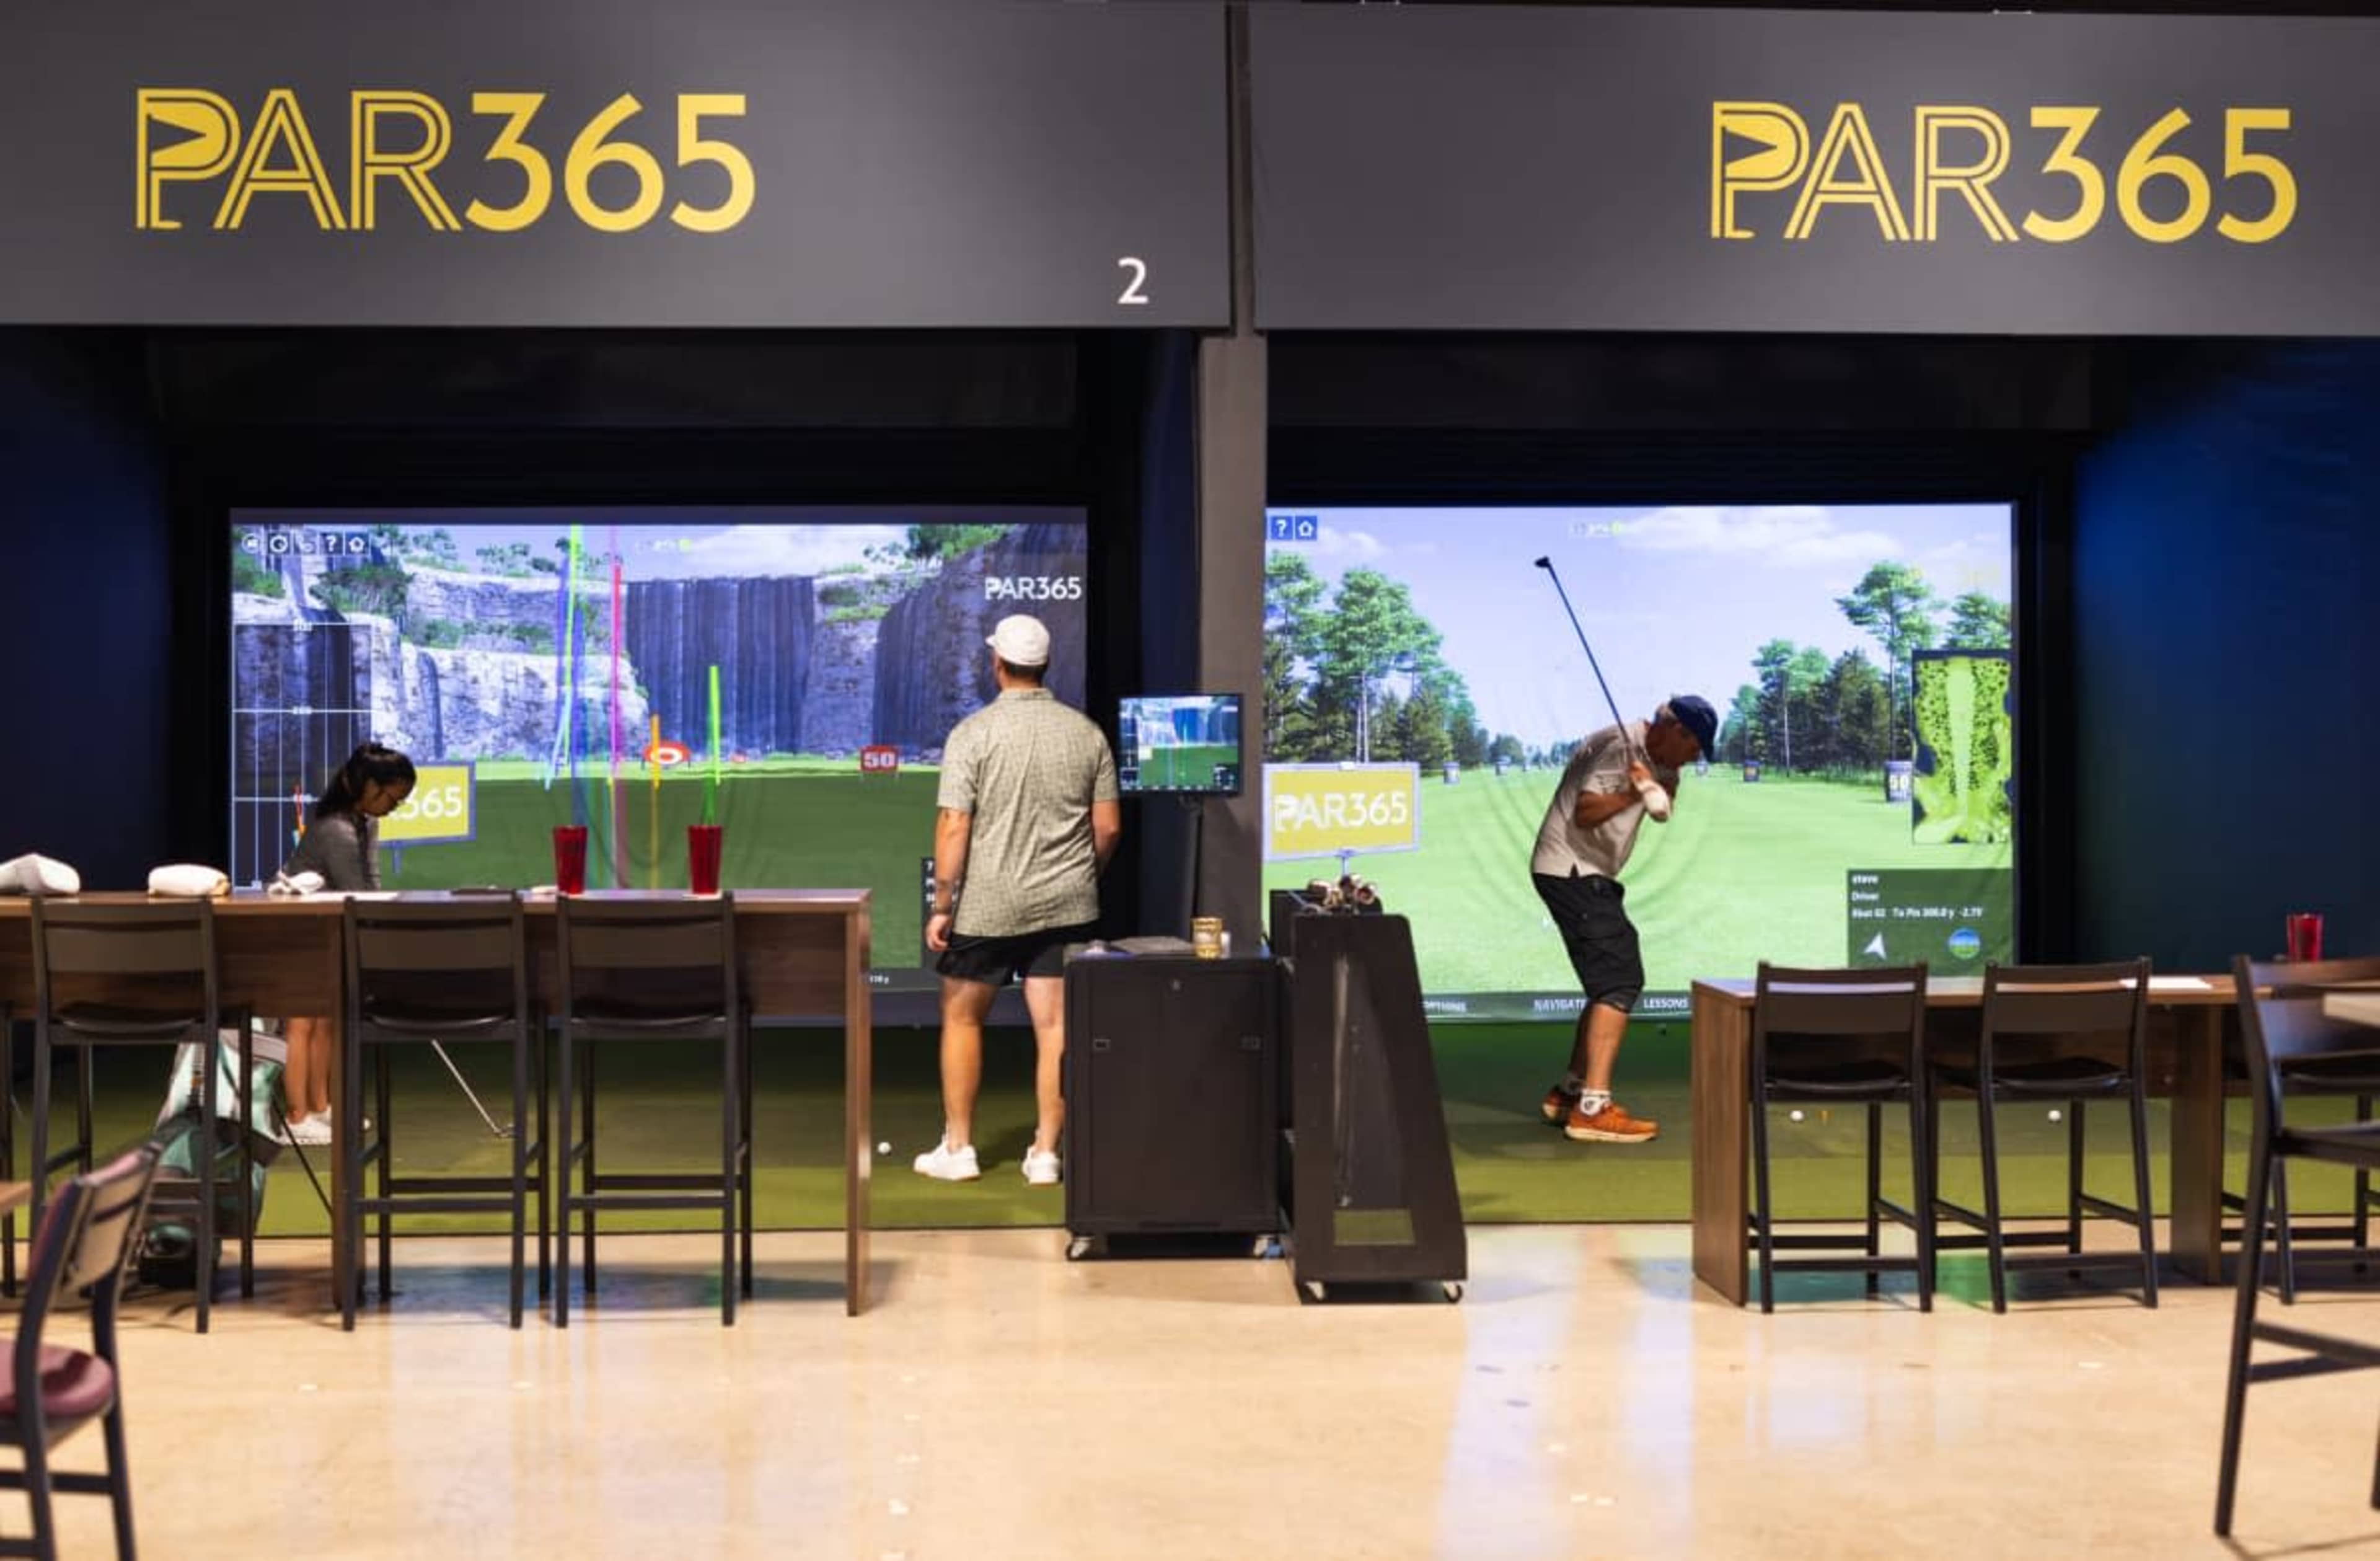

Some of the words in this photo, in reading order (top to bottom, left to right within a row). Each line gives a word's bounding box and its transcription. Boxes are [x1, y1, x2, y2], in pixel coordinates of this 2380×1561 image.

[136, 89, 756, 232] PAR365
[1711, 101, 2298, 243] PAR365
[1118, 257, 1148, 304] 2
[985, 577, 1082, 600] PAR365
[864, 751, 895, 767] 50
[1274, 790, 1408, 833] PAR365
[1644, 998, 1688, 1009] LESSONS
